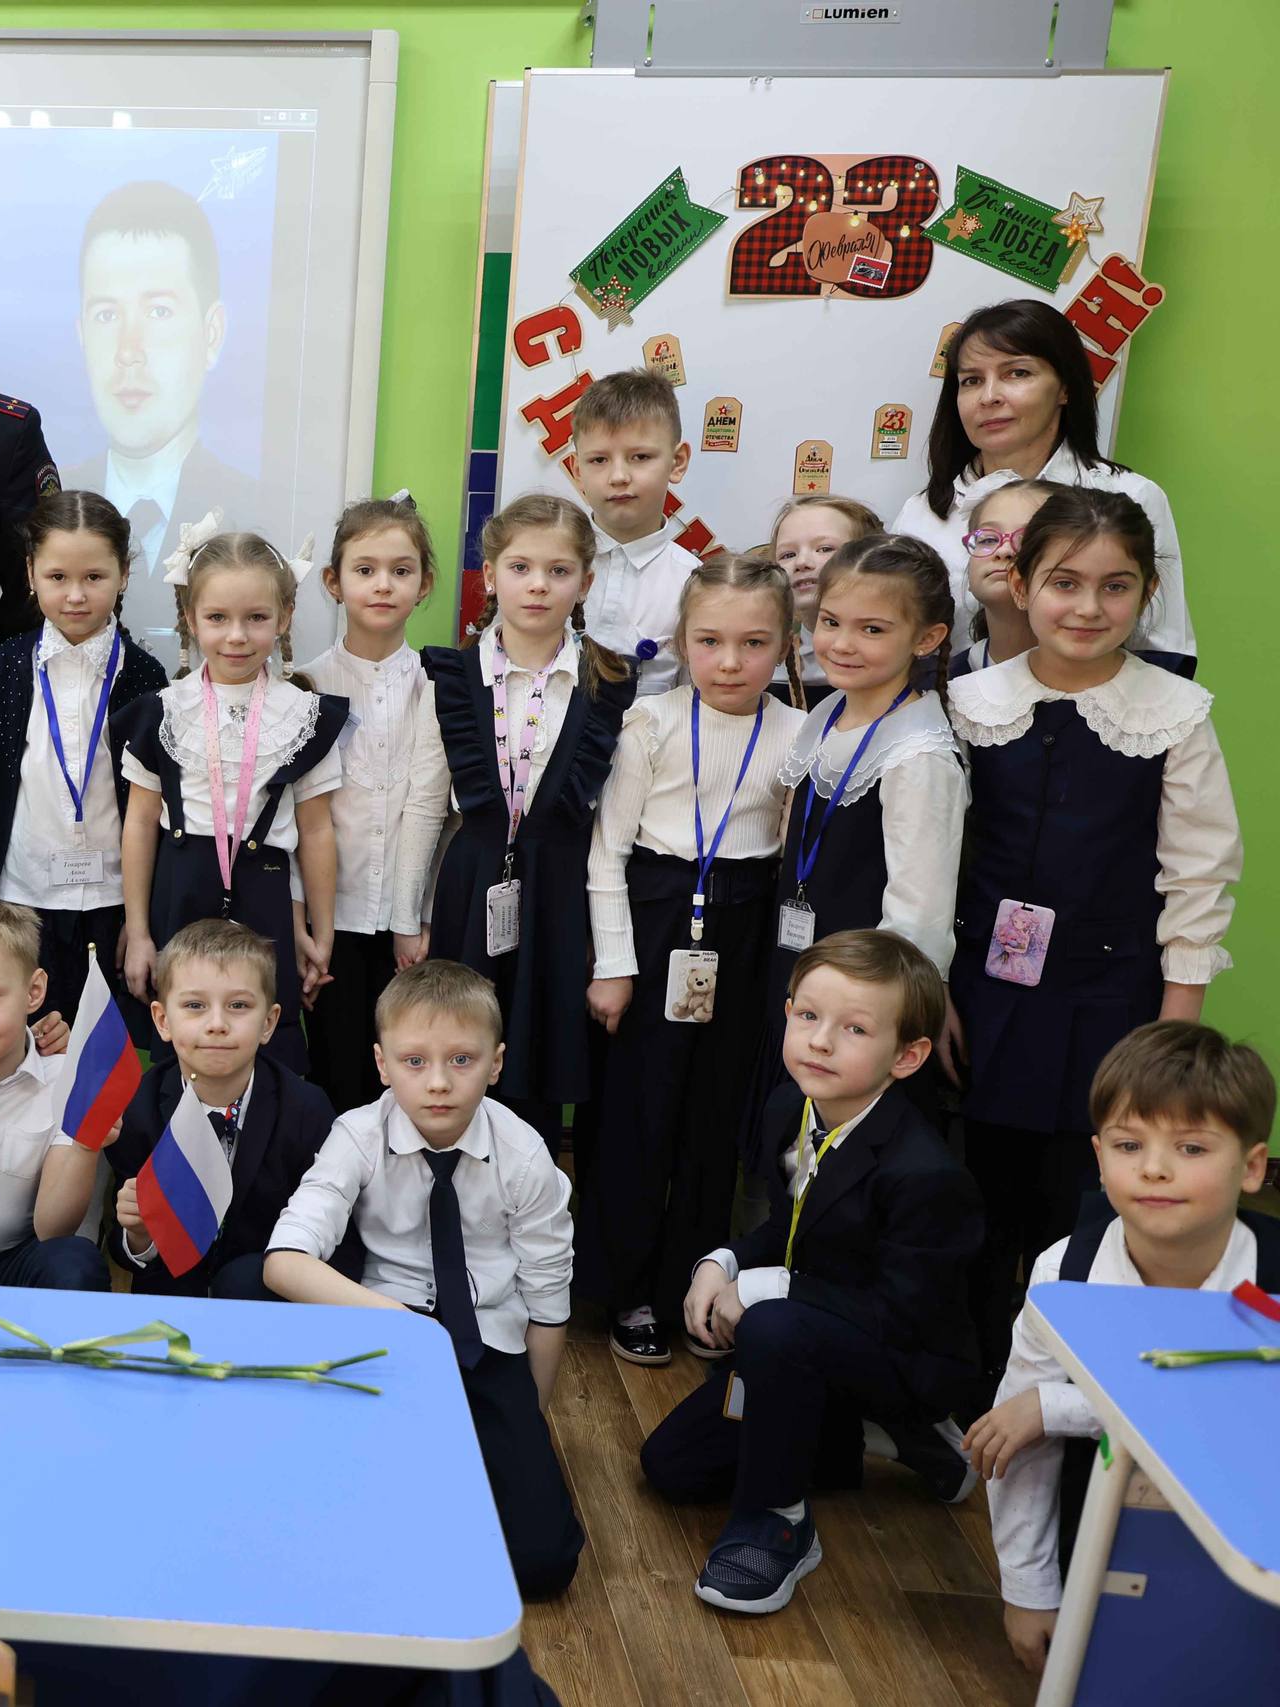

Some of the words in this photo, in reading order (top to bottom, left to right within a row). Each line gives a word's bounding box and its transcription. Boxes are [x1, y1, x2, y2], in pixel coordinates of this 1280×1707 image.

[824, 8, 889, 19] Lumien
[617, 208, 692, 281] НОВЫХ
[730, 155, 940, 299] 23
[988, 217, 1061, 270] ПОБЕД
[707, 416, 736, 427] ДНЕМ
[882, 410, 906, 430] 23
